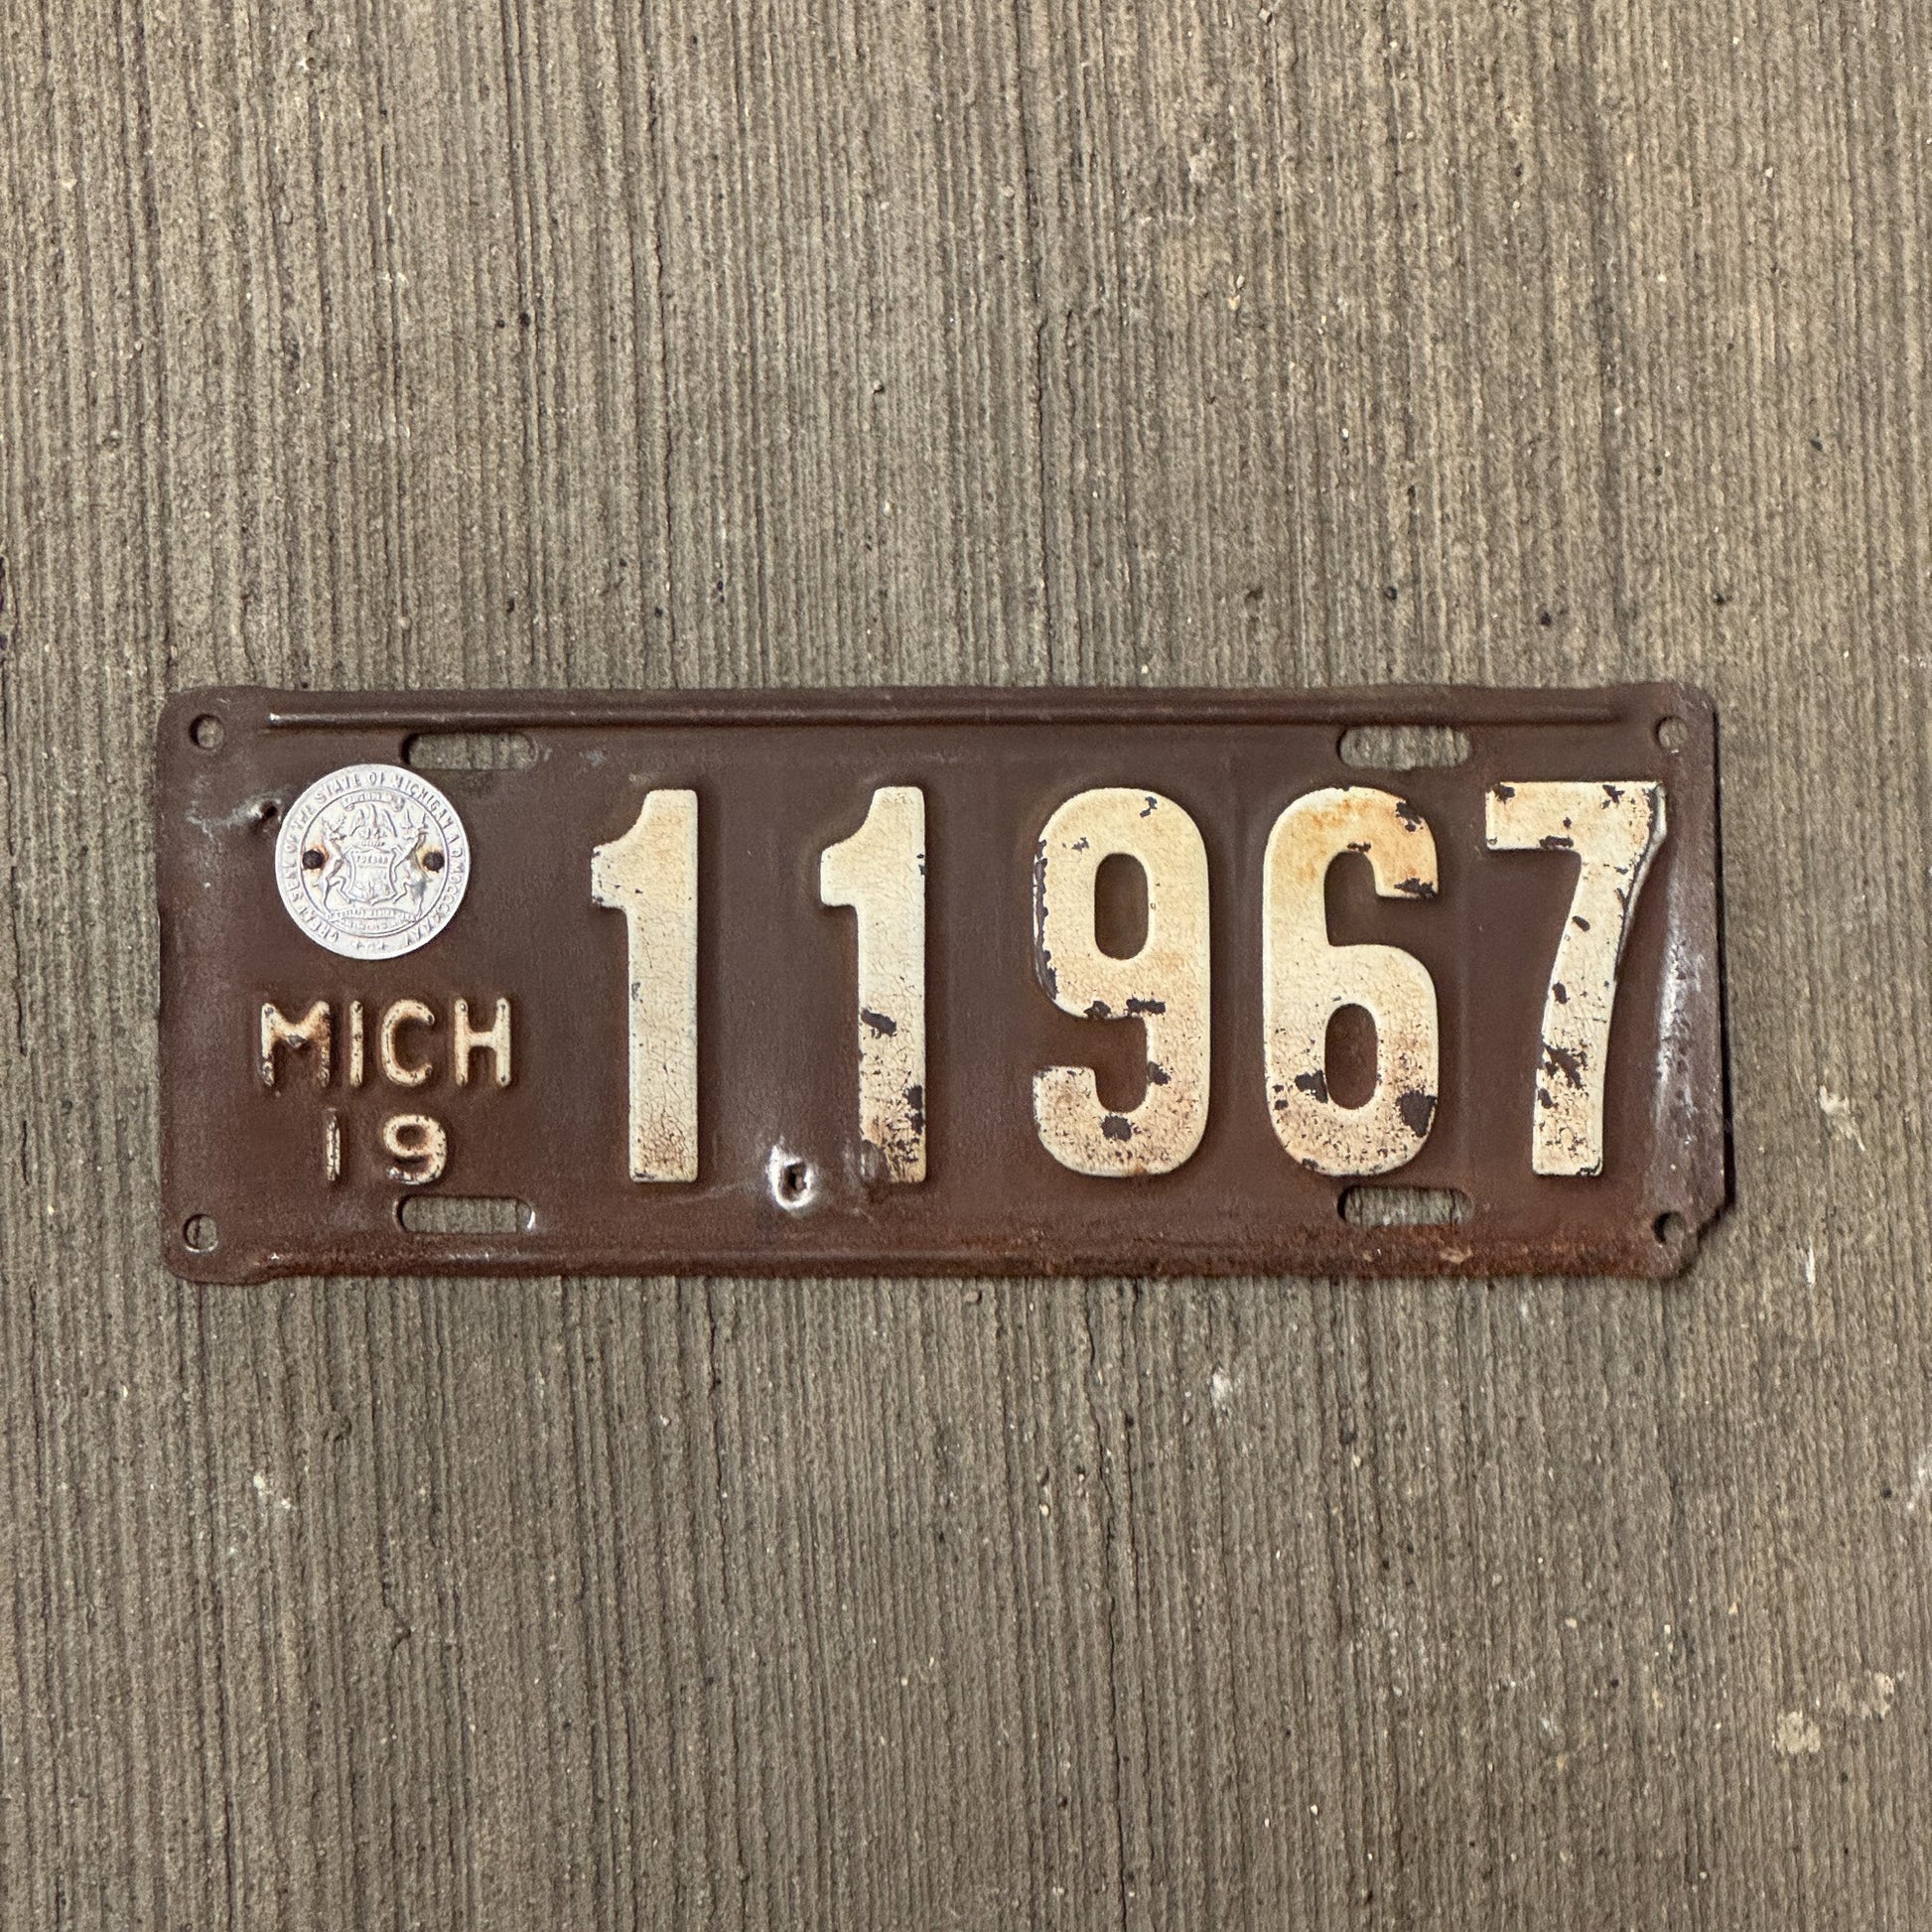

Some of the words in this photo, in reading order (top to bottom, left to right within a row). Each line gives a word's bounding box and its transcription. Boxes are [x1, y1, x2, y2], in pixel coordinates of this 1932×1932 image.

[315, 773, 361, 805] STATE
[369, 770, 385, 785] OF
[393, 773, 456, 830] MICHIGAN
[282, 861, 304, 902] SEAL
[299, 906, 340, 943] GREAT
[592, 780, 1666, 1182] 11967
[260, 999, 512, 1088] MICH
